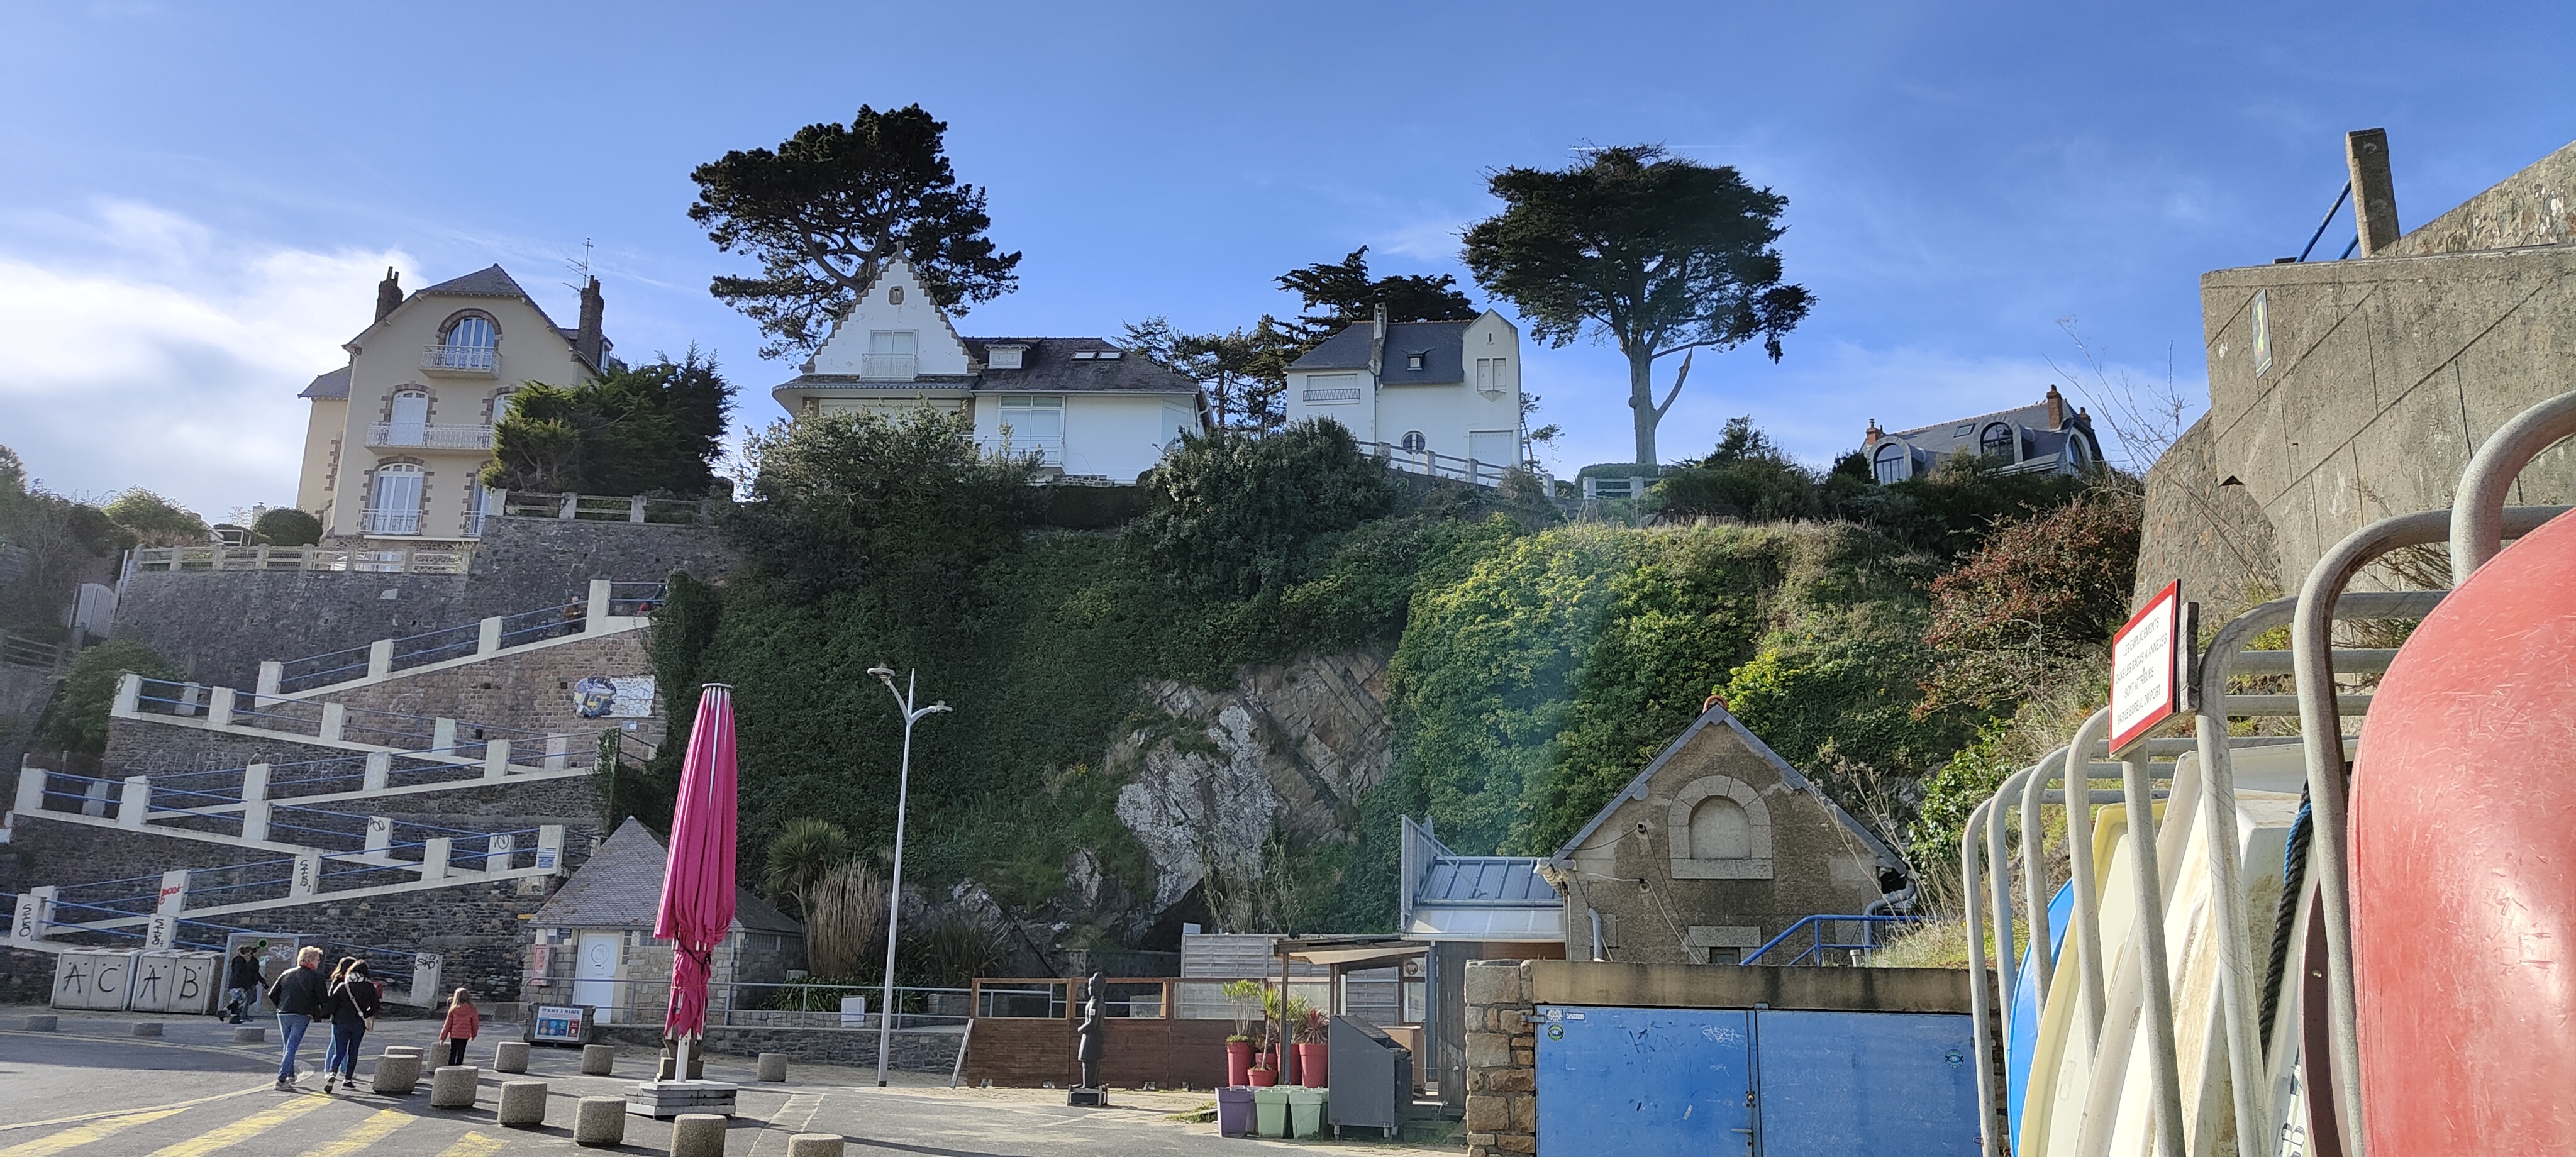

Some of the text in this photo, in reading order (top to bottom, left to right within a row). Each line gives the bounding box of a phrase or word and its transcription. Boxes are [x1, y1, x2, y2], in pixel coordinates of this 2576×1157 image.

[2129, 616, 2160, 651] EMPLACEMENTS
[2116, 668, 2125, 684] DANS
[2132, 651, 2144, 670] RACKS
[2148, 633, 2167, 657] ANNEXES
[2124, 682, 2135, 699] SONT
[2124, 707, 2129, 720] LE
[2129, 696, 2144, 717] BUREAU
[2144, 692, 2150, 706] DU
[2150, 684, 2161, 701] PORT
